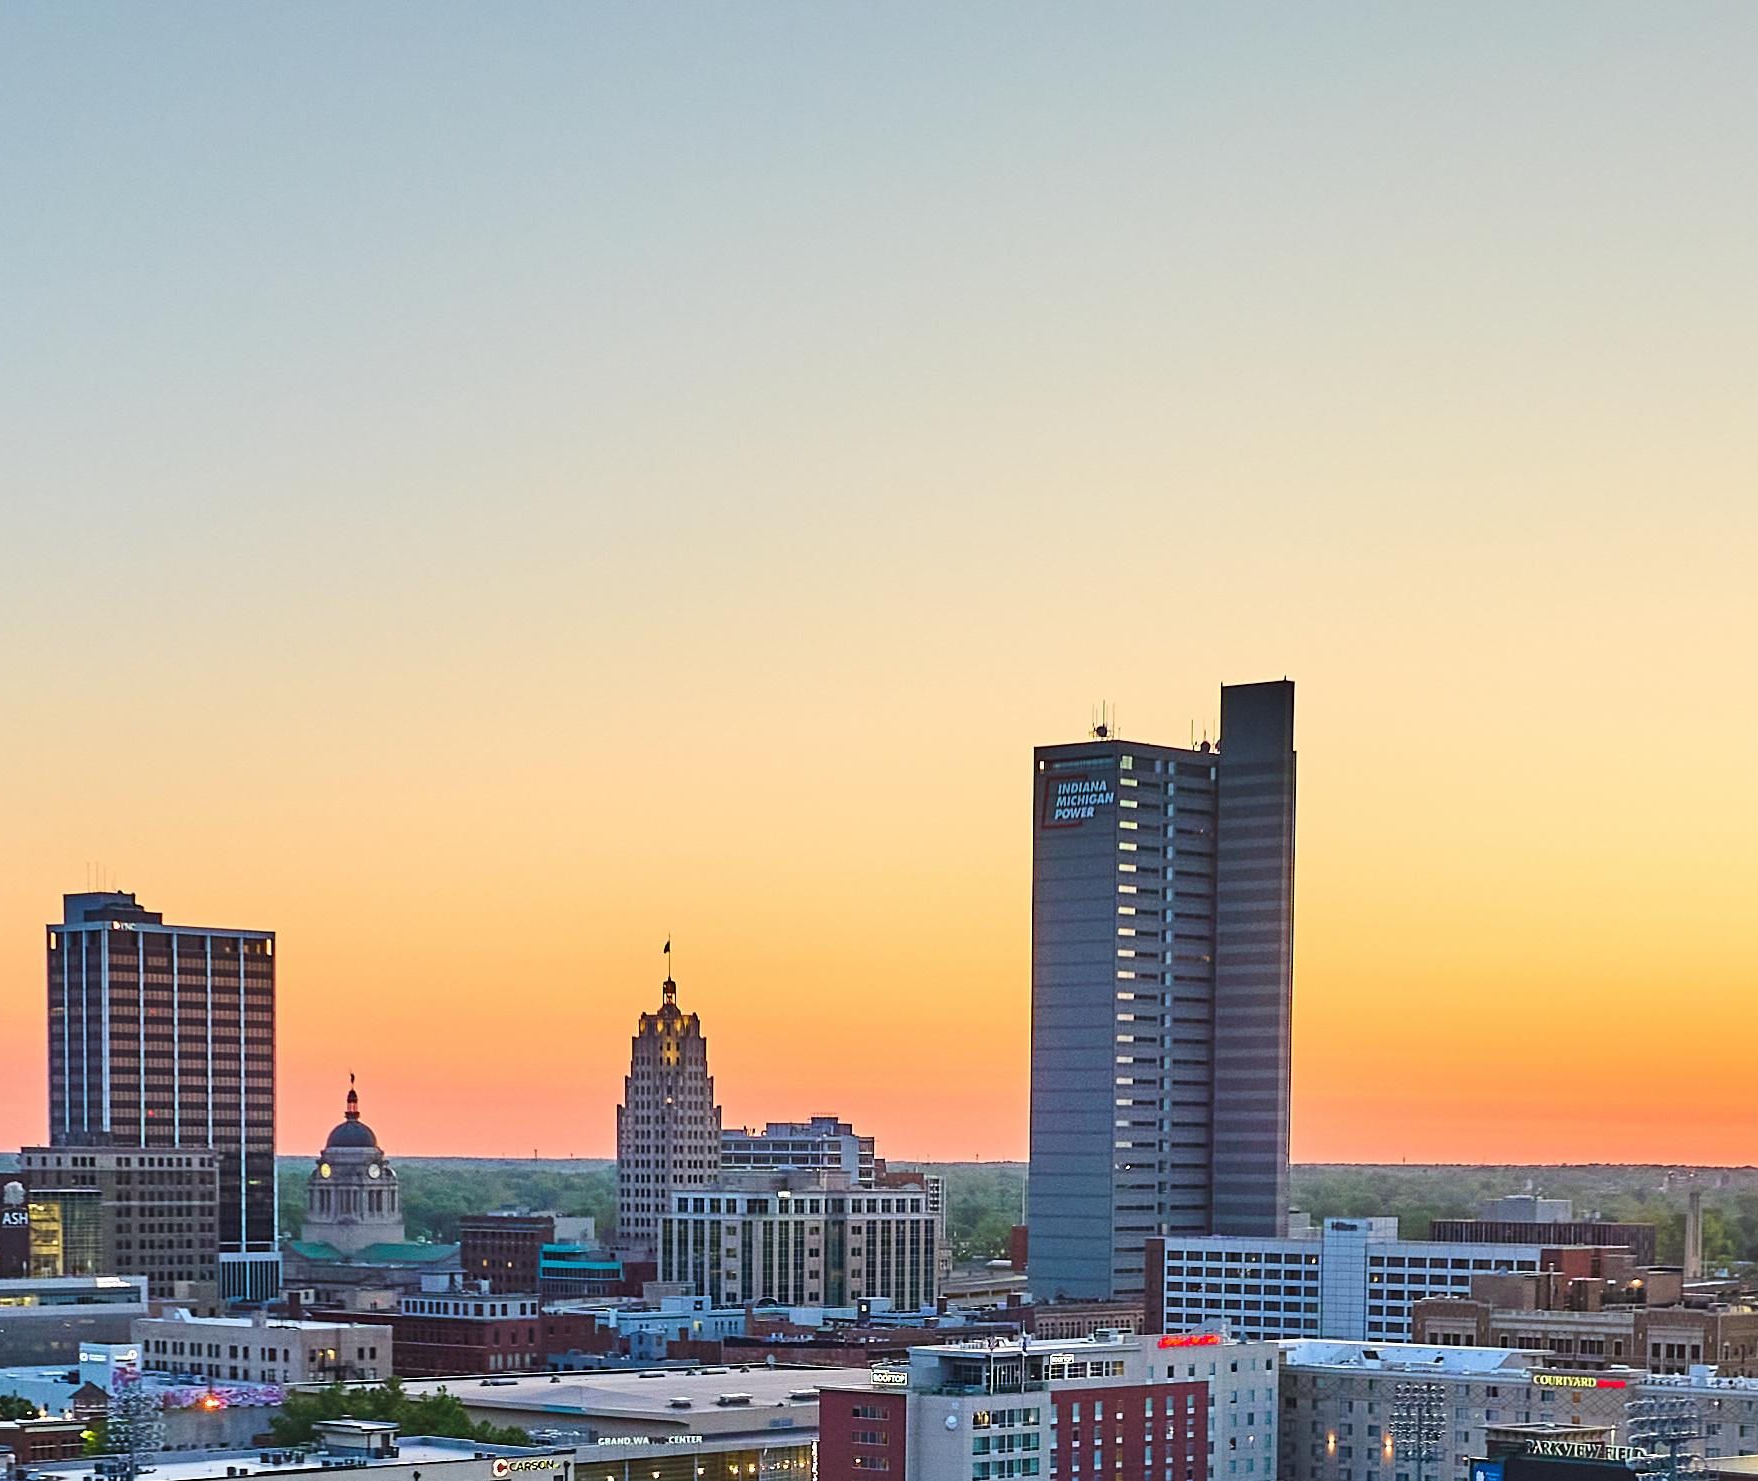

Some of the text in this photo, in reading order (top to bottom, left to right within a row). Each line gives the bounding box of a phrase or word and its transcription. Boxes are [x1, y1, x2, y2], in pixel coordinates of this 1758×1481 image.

[1058, 781, 1107, 795] INDIANA
[1056, 792, 1115, 807] MICHIGAN
[1055, 806, 1095, 820] POWER
[2, 1212, 29, 1225] ASH
[872, 1372, 907, 1385] ROOFTOP
[1533, 1374, 1597, 1388] COURTYARD
[598, 1436, 631, 1446] GRAND
[668, 1435, 703, 1444] CENTER
[1525, 1438, 1602, 1459] PARKVIEW
[509, 1459, 554, 1472] CARSON
